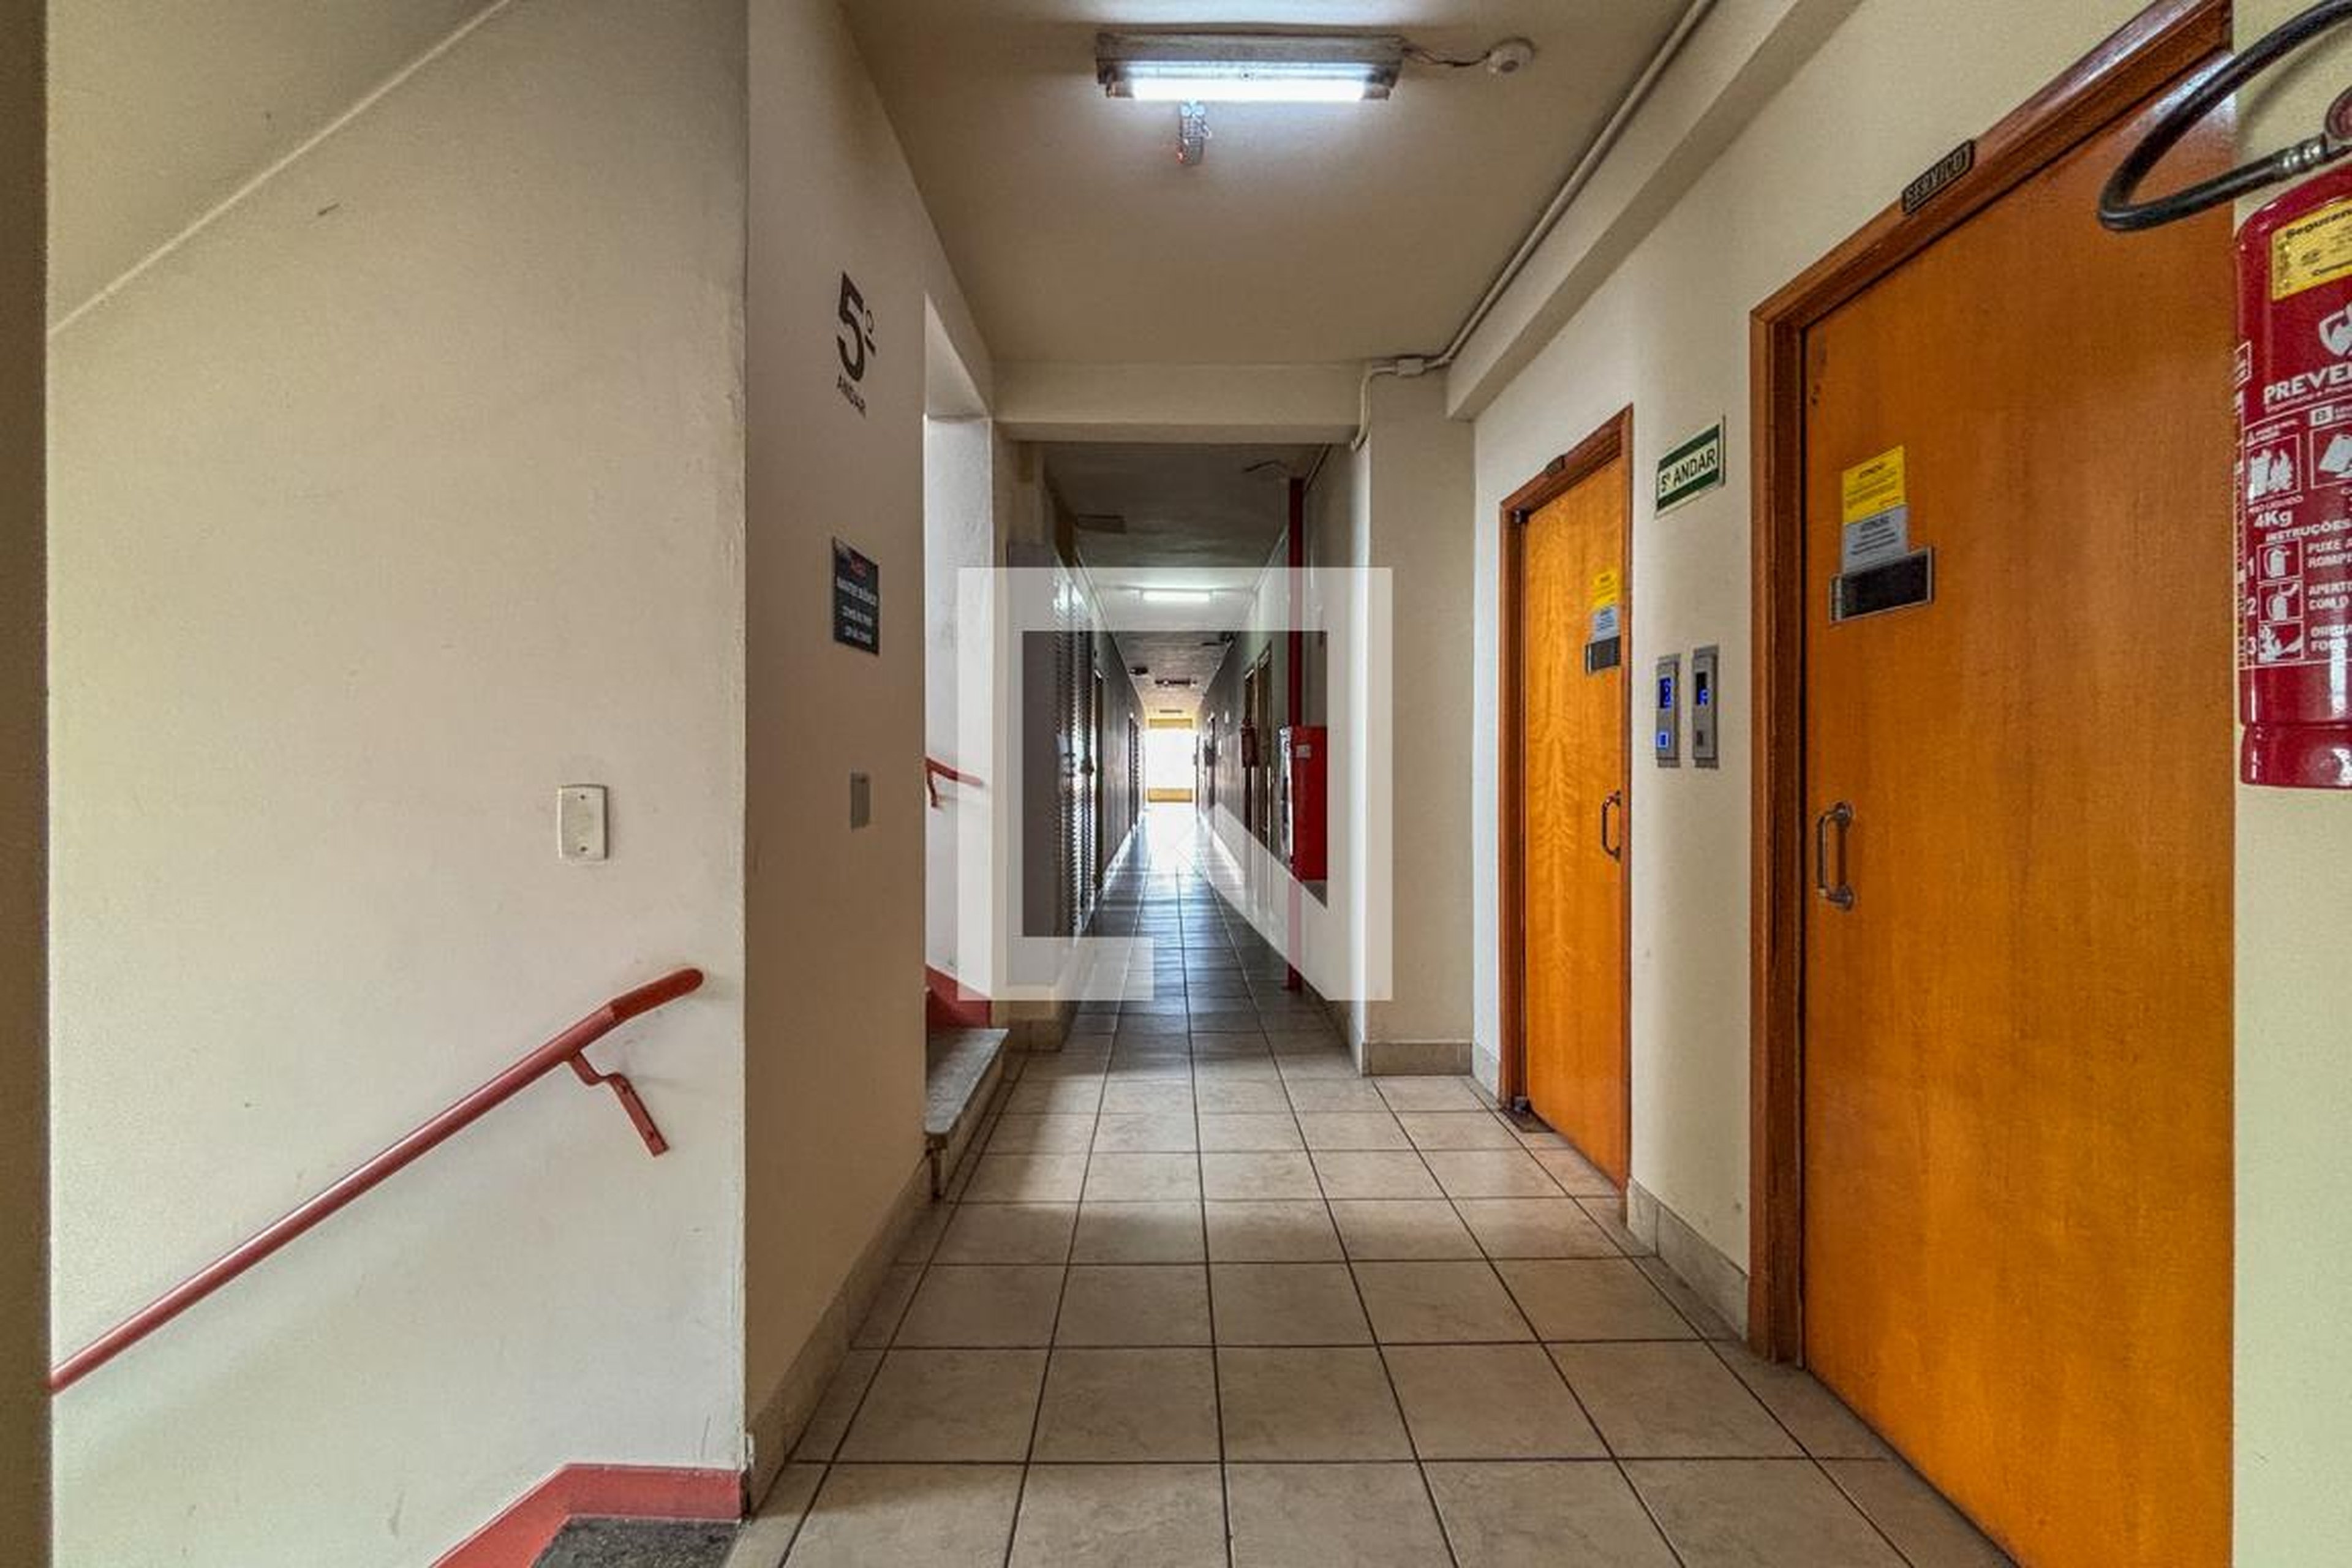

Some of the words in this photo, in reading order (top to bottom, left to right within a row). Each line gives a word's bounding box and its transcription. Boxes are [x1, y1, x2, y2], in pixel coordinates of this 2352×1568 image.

[2263, 363, 2352, 406] PREVE
[1673, 448, 1716, 488] ANDAR
[2253, 510, 2293, 528] 4Kg
[2307, 540, 2342, 554] PUXE
[2247, 557, 2255, 577] 1
[2247, 597, 2256, 616] 2
[2247, 636, 2257, 655] 3
